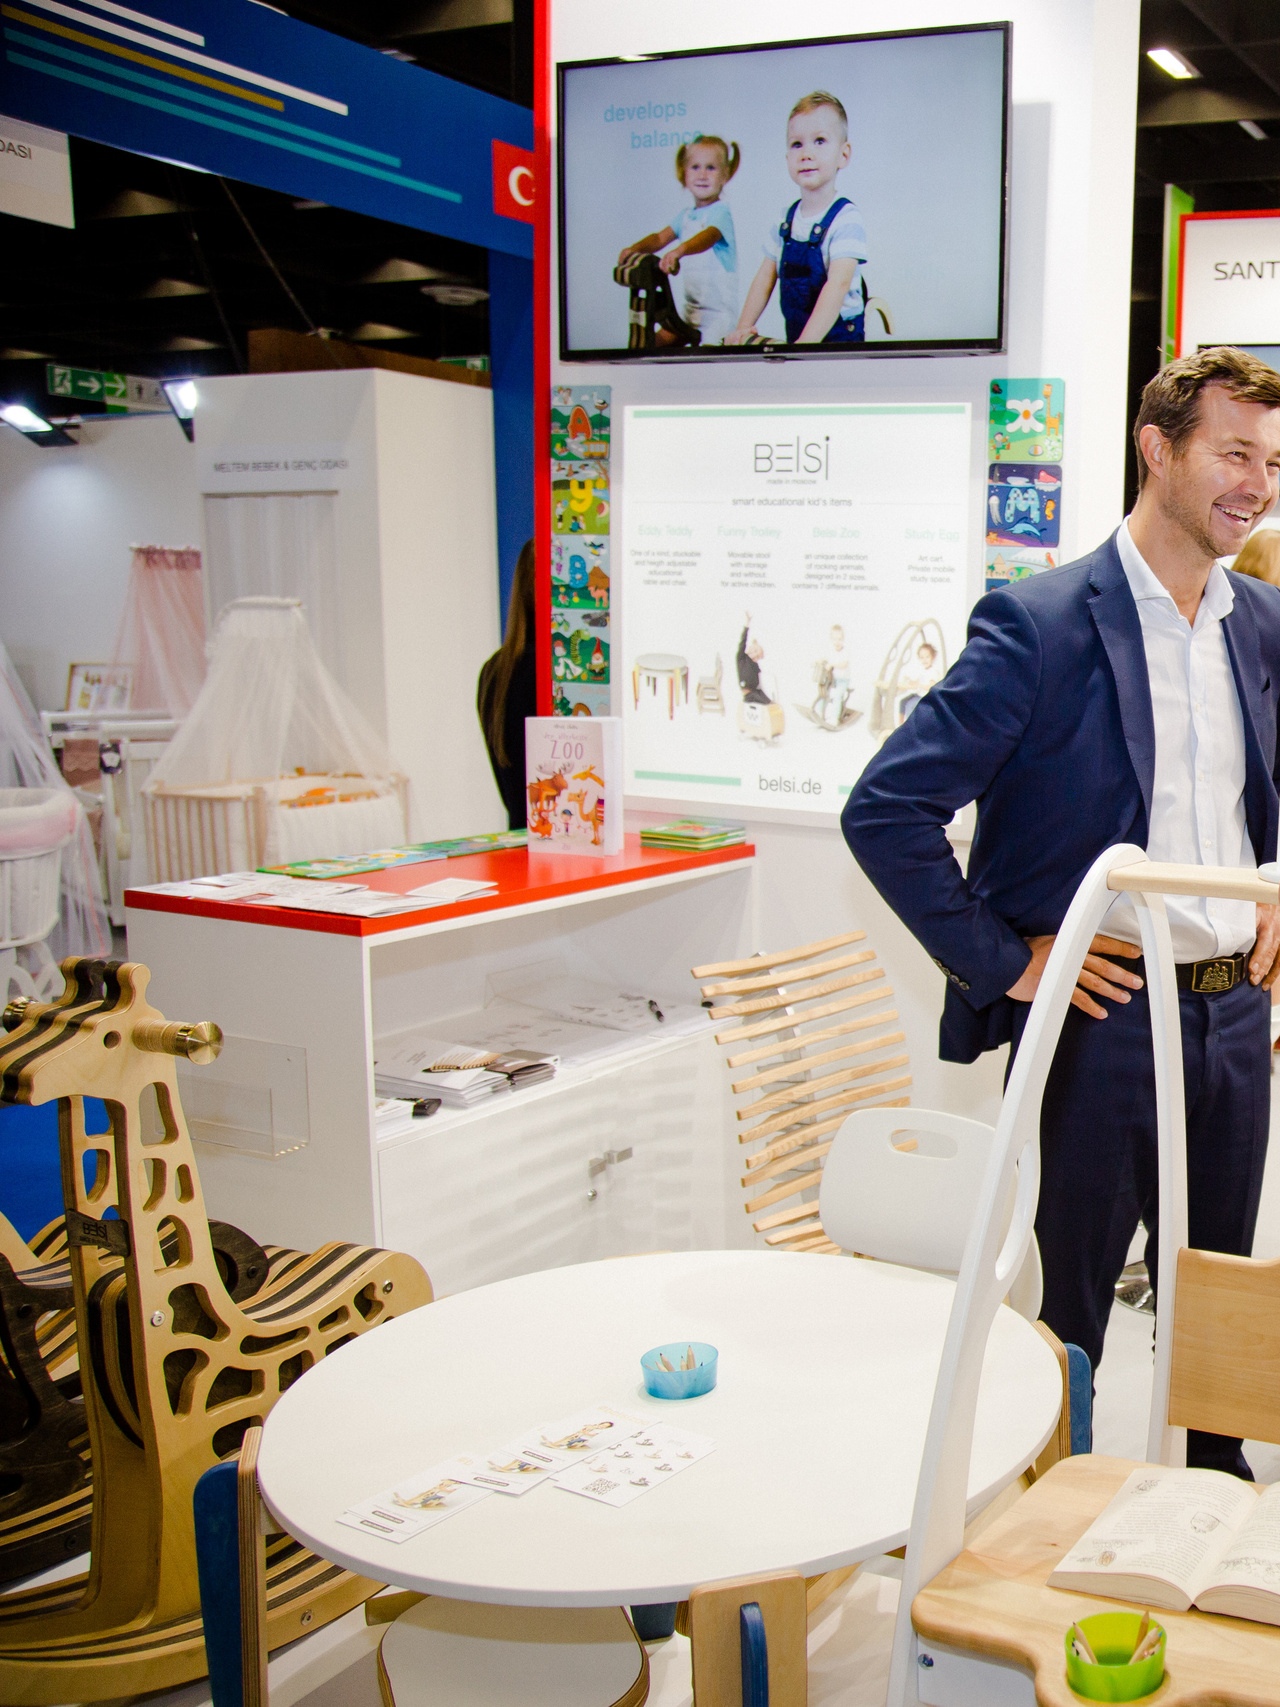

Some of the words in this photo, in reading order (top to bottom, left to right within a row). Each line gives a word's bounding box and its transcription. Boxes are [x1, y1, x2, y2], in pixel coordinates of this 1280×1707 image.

[603, 101, 687, 122] develops
[630, 130, 703, 149] balance
[732, 498, 755, 506] smart
[757, 498, 805, 506] educational
[829, 498, 852, 507] items
[717, 526, 746, 539] Funny
[751, 526, 781, 540] Trolley
[840, 527, 860, 539] Zoo
[904, 528, 935, 541] Study
[939, 529, 960, 542] Egg
[550, 740, 584, 760] ZOO
[759, 774, 822, 795] belsi.de
